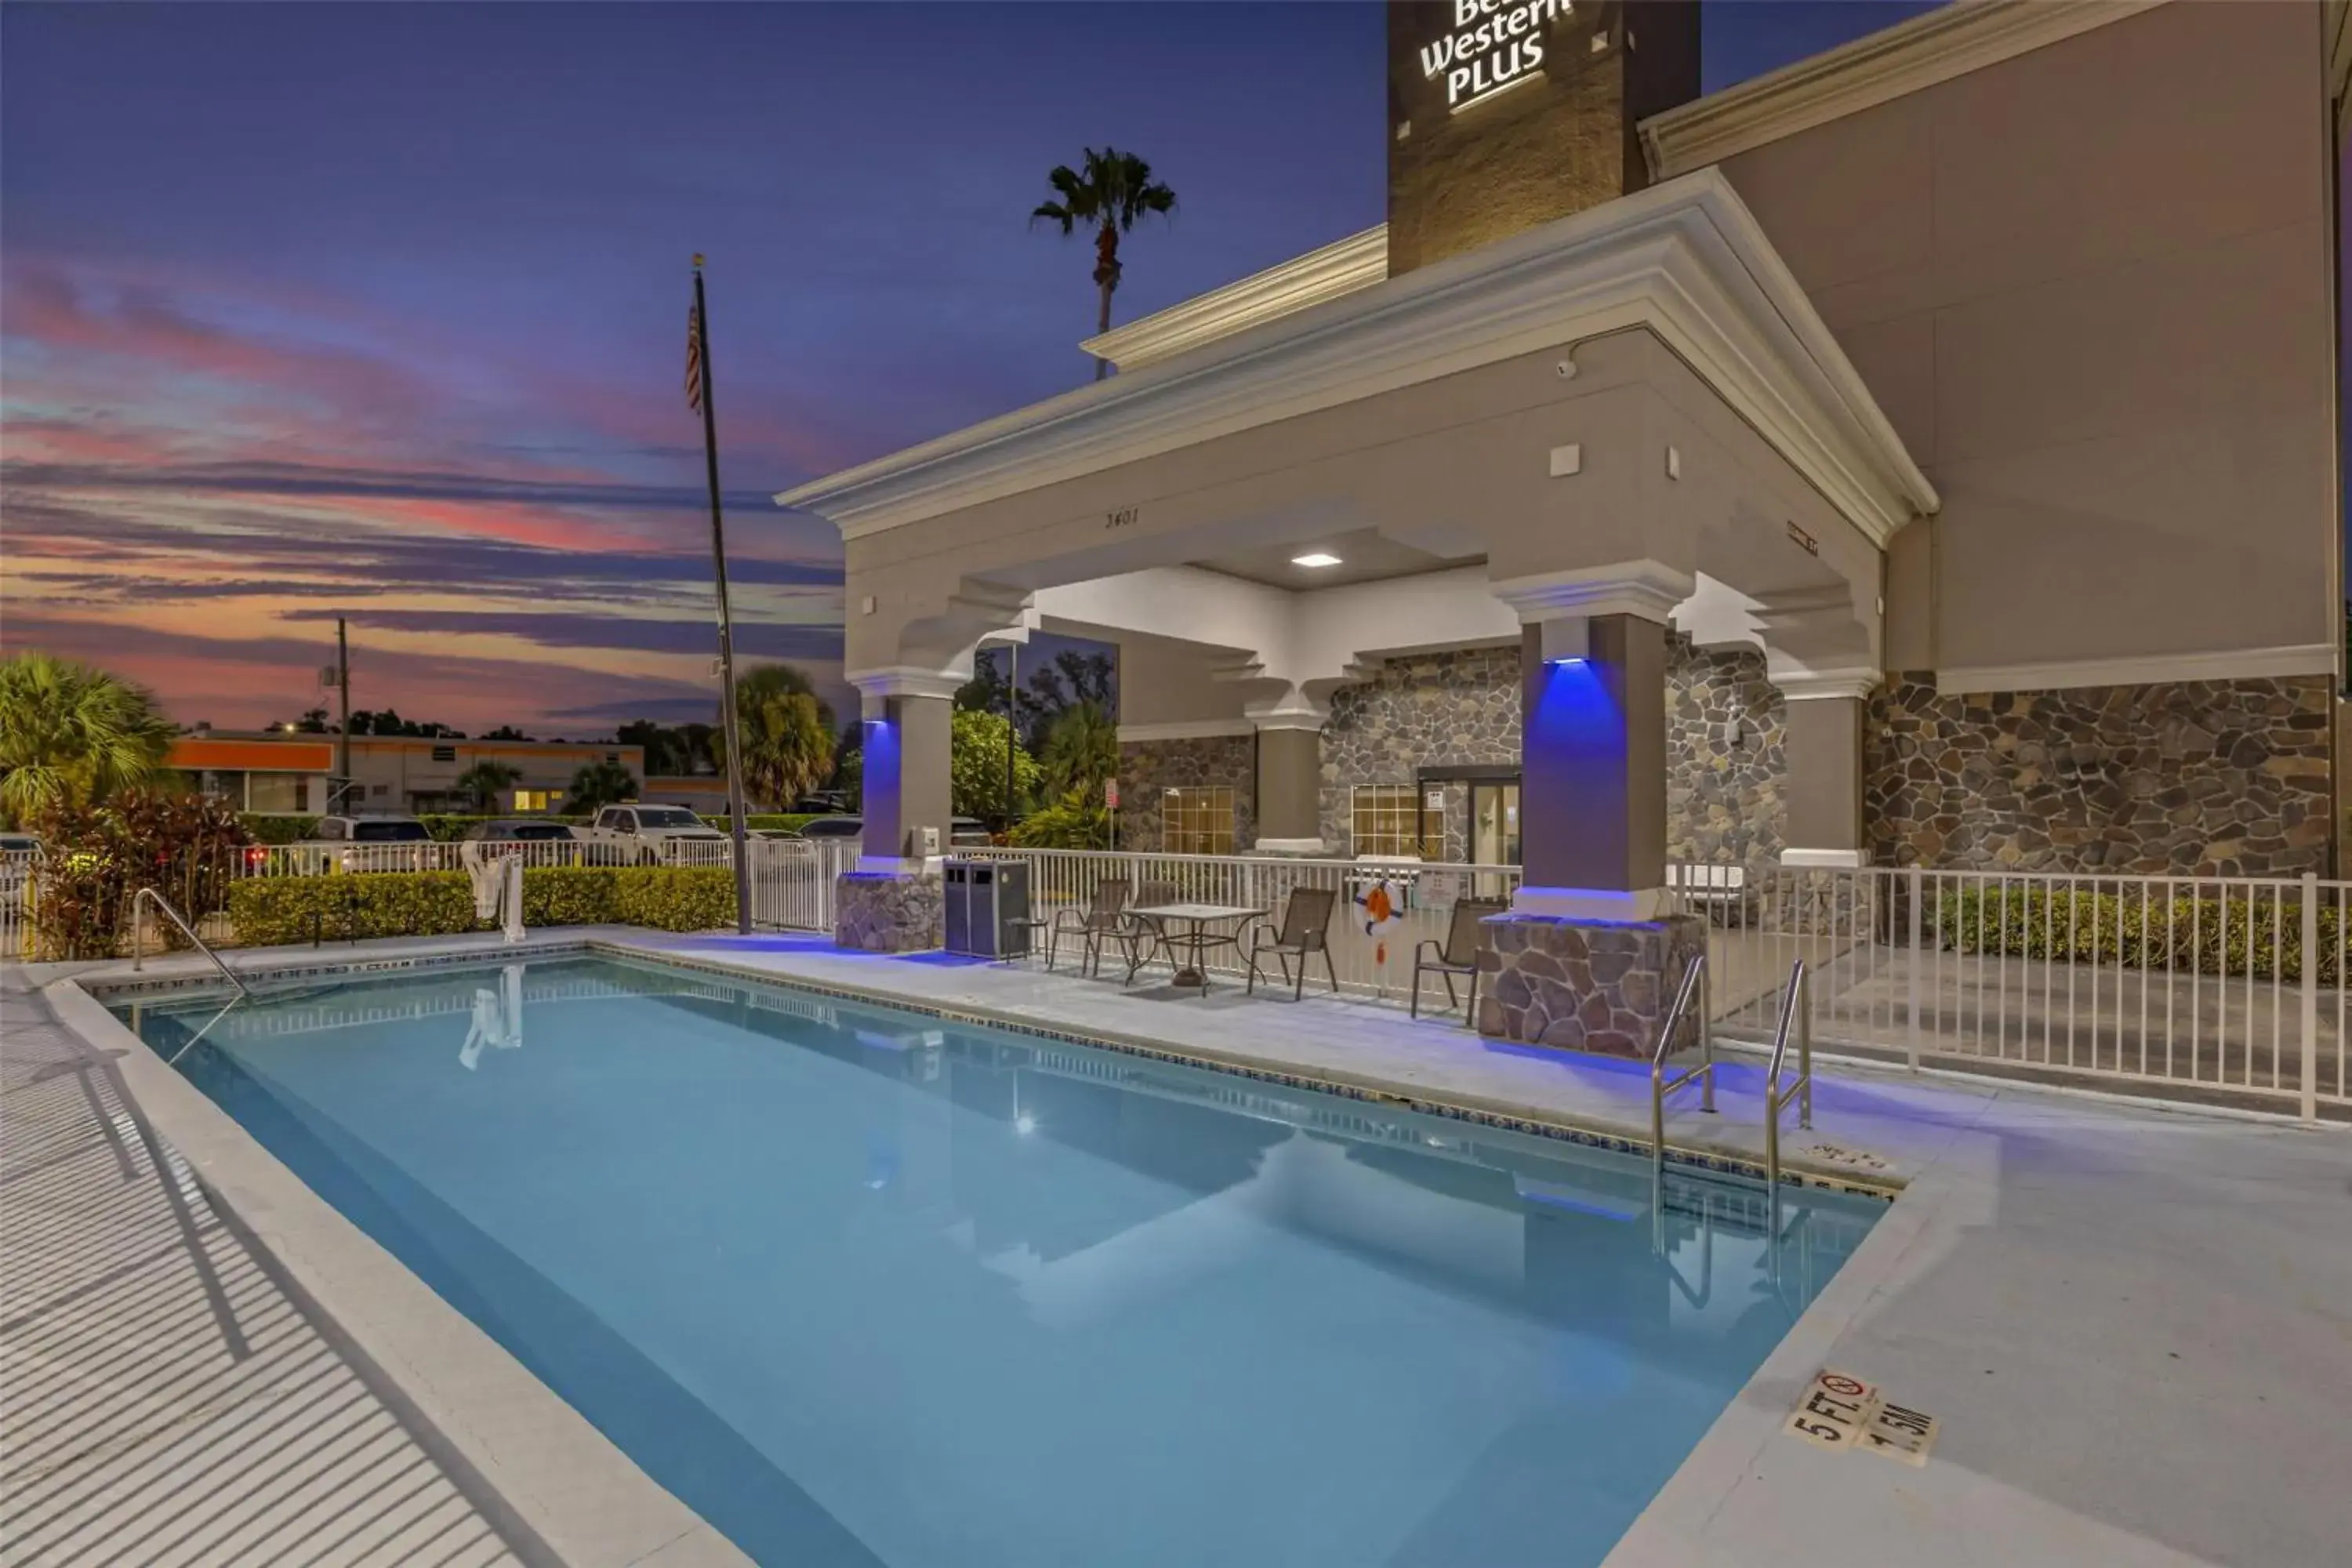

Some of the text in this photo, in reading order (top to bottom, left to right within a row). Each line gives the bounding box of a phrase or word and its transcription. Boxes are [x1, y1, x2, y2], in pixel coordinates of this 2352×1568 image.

[1455, 0, 1513, 27] Be
[1447, 30, 1544, 104] PLUS
[1794, 1417, 1842, 1442] 5
